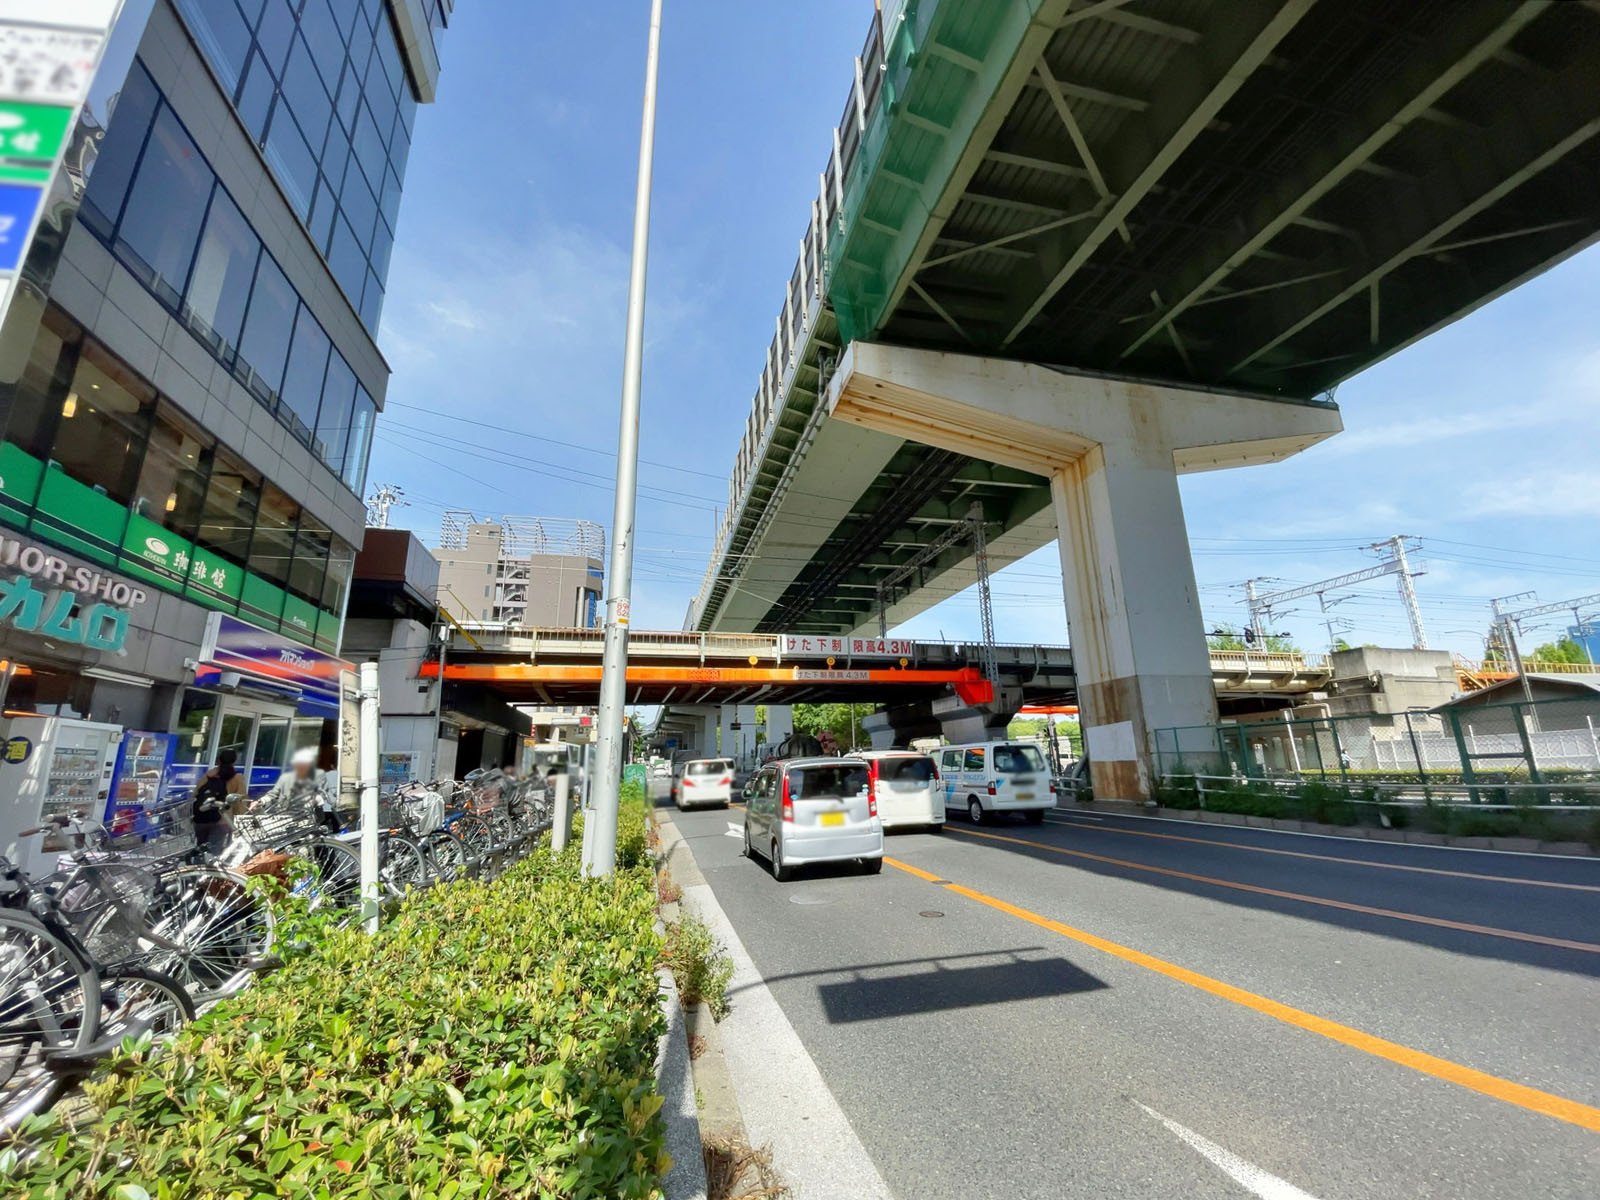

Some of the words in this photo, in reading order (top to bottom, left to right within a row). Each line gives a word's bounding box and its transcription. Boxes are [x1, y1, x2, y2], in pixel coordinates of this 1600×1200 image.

[72, 567, 147, 608] SHOP
[786, 638, 842, 652] けた下制
[853, 640, 912, 655] 限高4.3M
